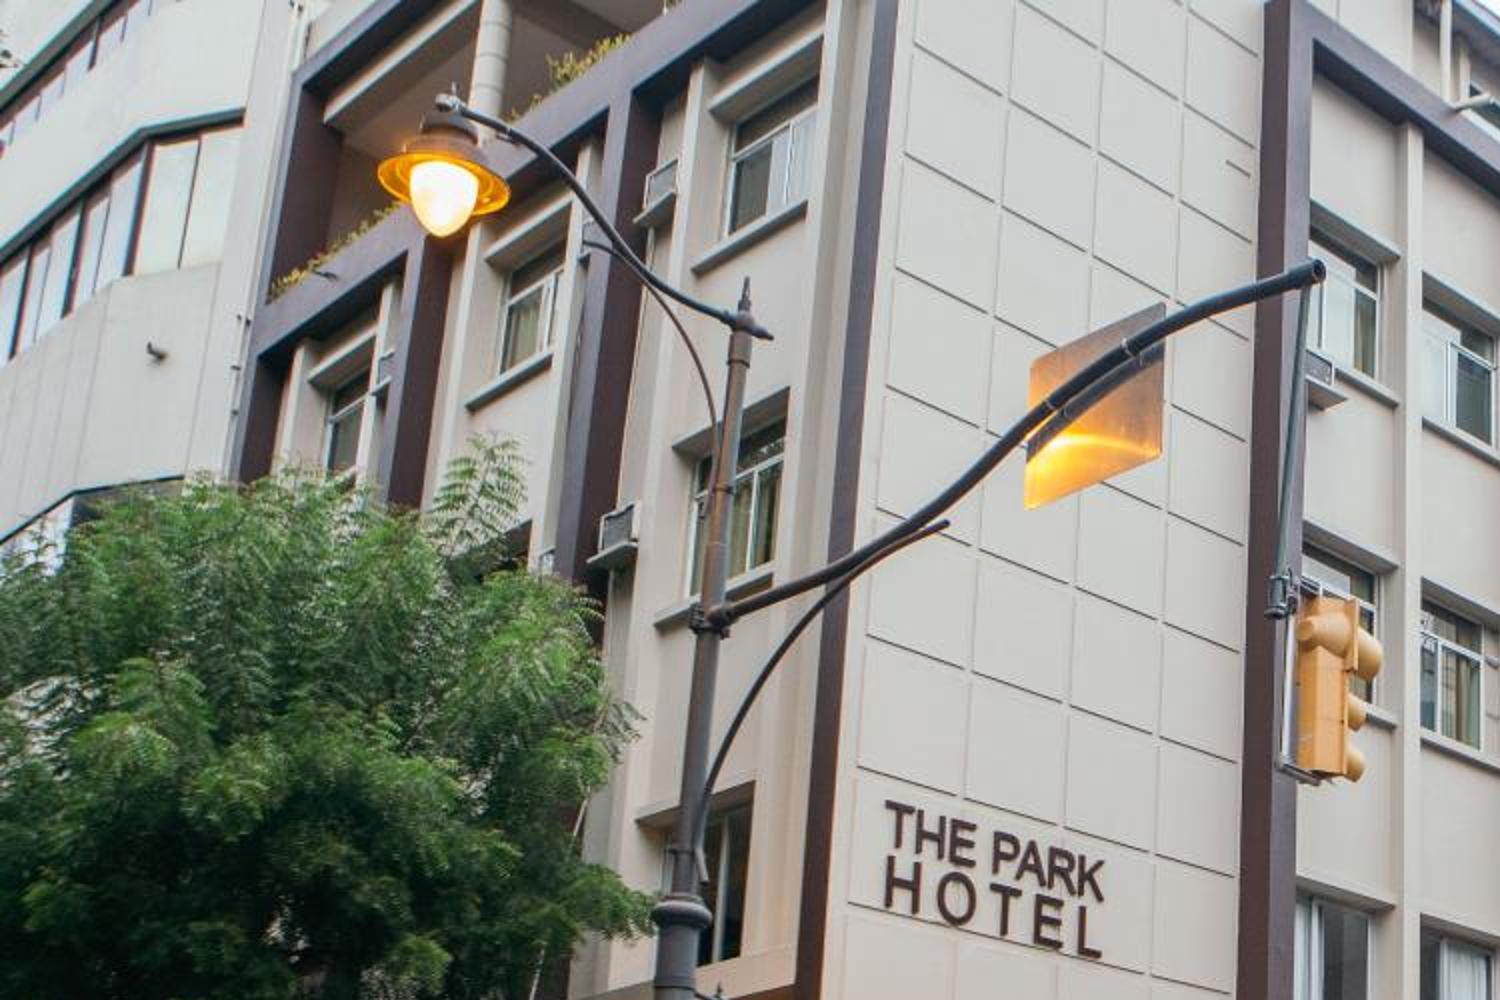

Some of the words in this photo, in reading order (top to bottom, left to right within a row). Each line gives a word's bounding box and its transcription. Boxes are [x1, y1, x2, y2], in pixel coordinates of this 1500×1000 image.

[885, 800, 977, 868] THE
[991, 830, 1105, 903] PARK
[884, 855, 1103, 959] HOTEL
